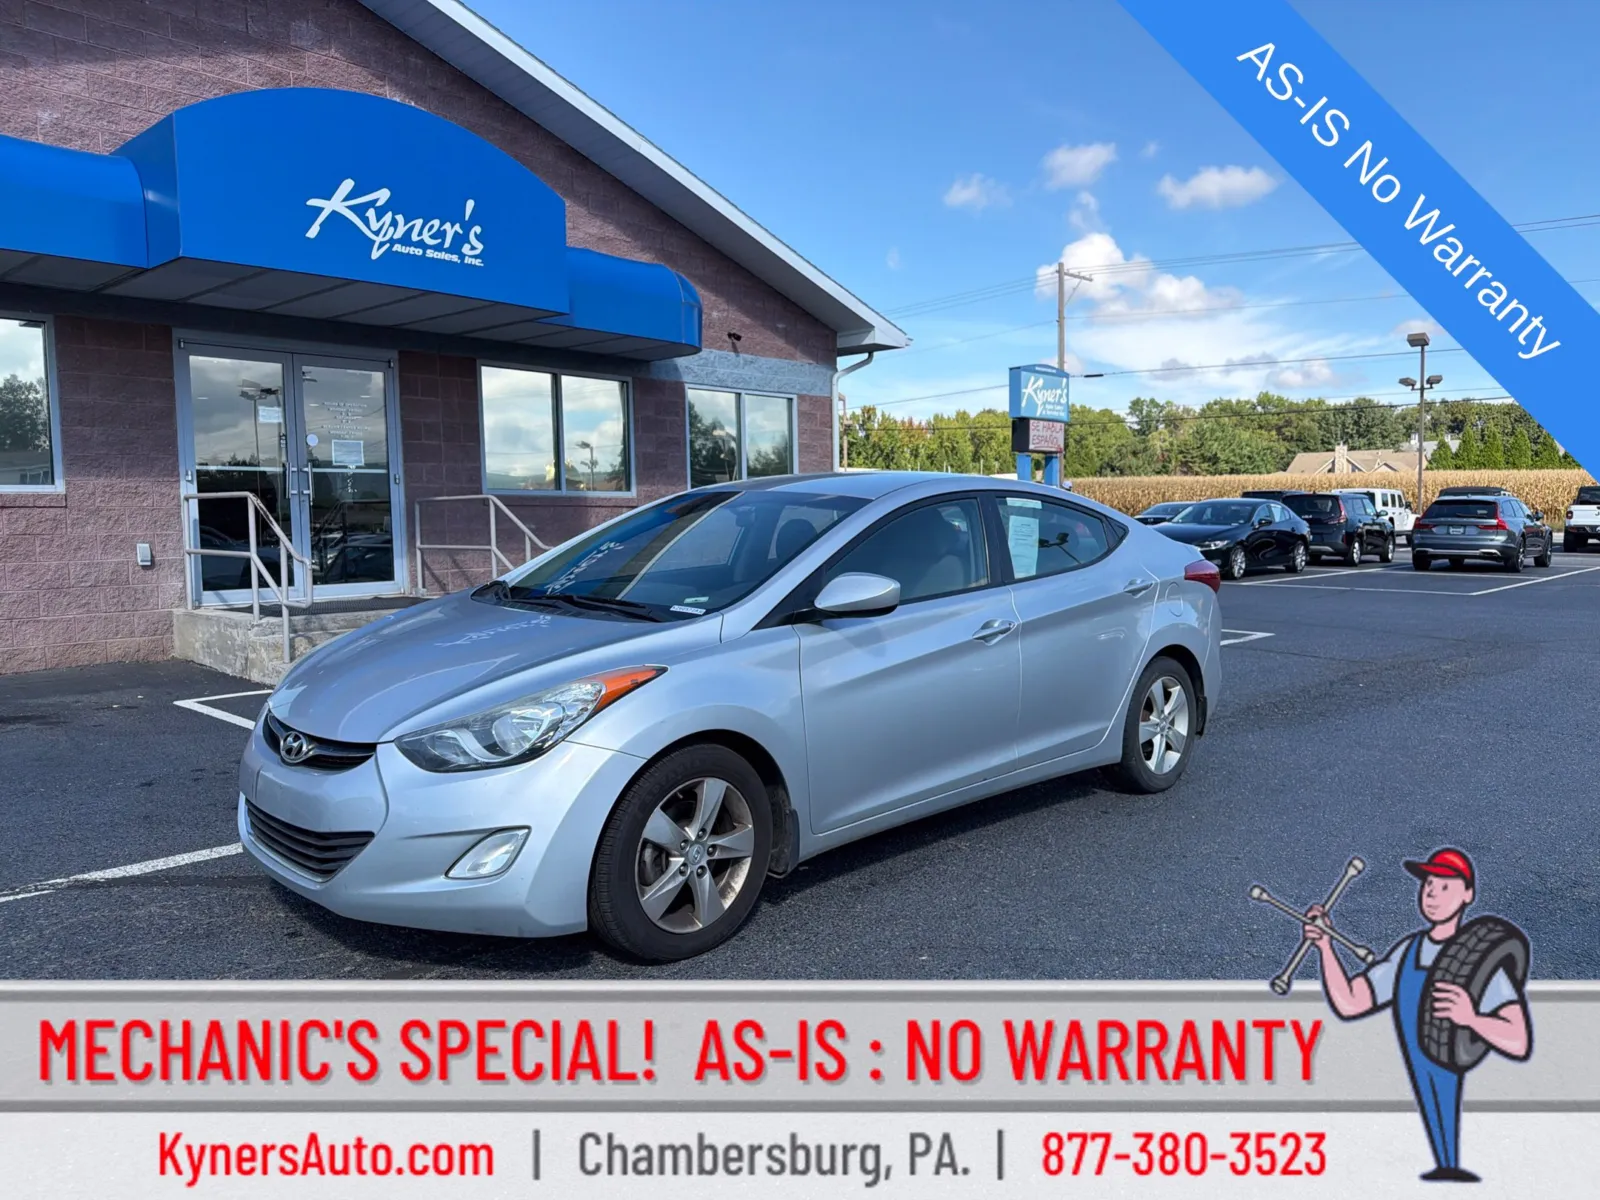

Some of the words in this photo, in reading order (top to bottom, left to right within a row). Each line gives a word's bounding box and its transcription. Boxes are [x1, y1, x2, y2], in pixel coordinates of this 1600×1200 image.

[305, 178, 484, 260] Kyner's
[391, 243, 423, 256] Auto
[425, 249, 461, 263] Sales,
[463, 256, 485, 267] Inc.
[1021, 375, 1067, 417] Kyner's
